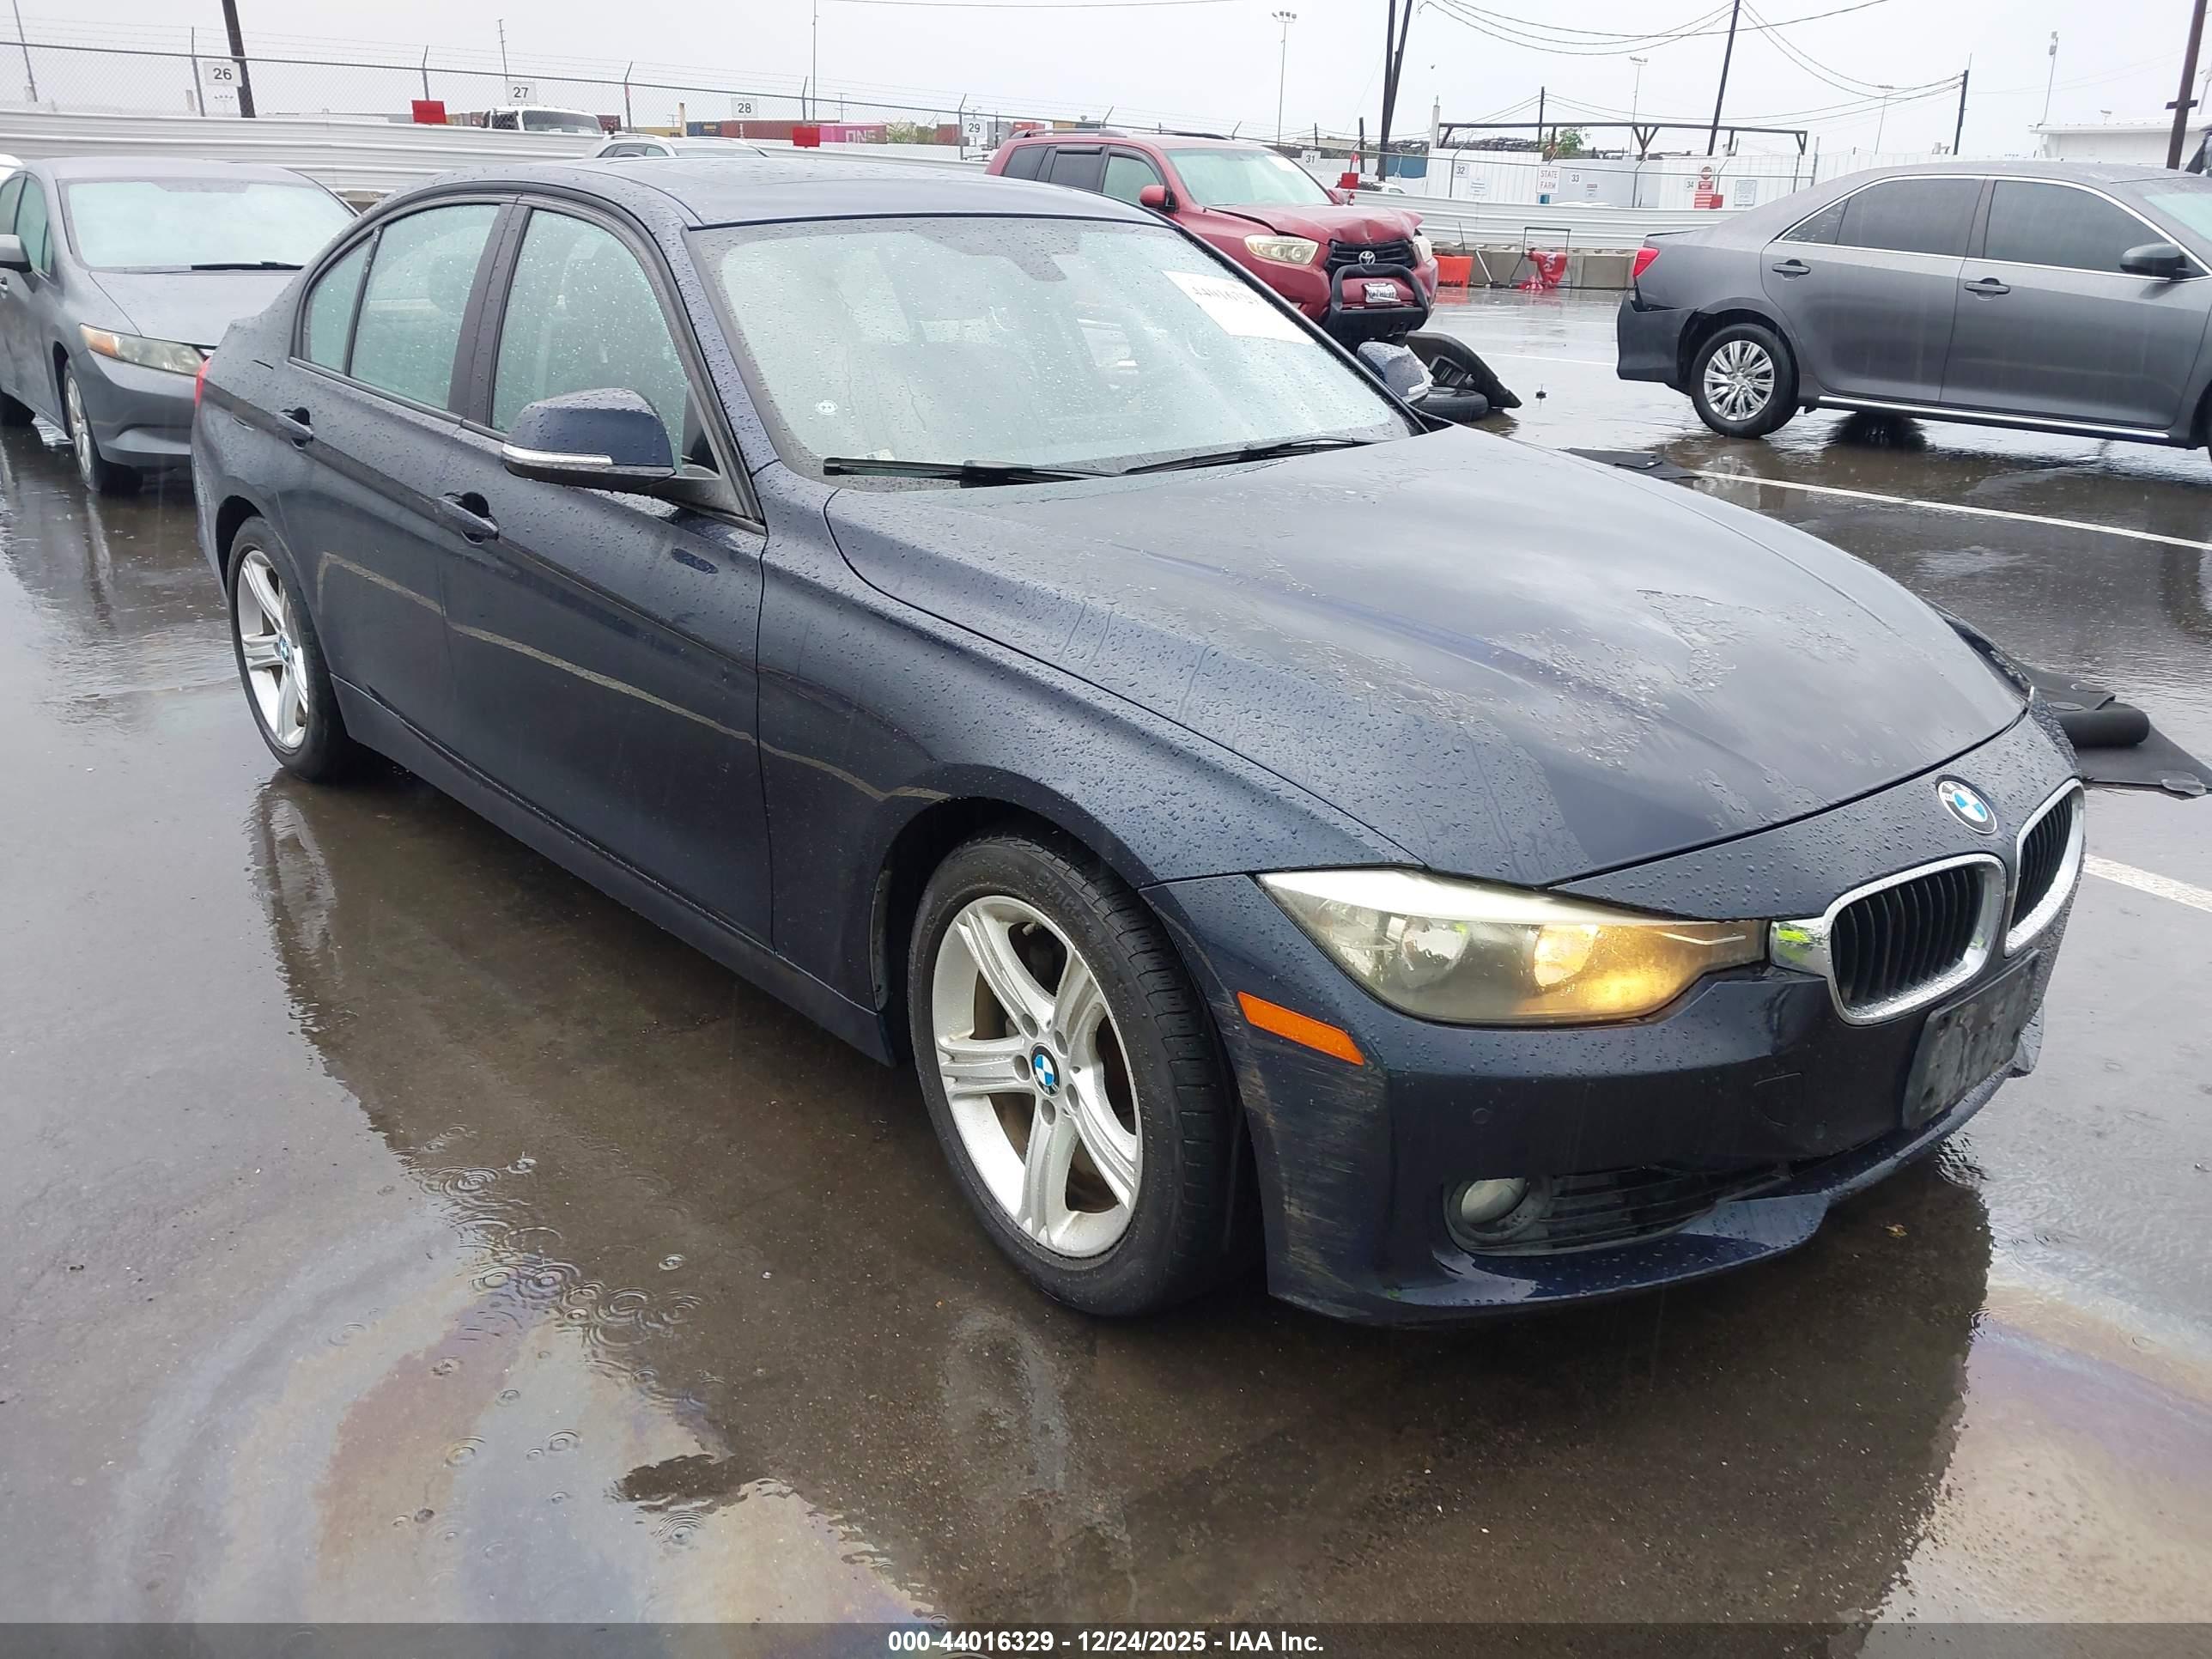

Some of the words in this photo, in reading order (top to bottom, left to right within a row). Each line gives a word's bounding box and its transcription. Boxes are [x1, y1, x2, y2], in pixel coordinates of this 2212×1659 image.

[212, 67, 233, 81] 26
[513, 87, 529, 98] 27
[738, 102, 751, 113] 28
[968, 122, 981, 133] 29
[1305, 155, 1316, 164] 31
[1455, 165, 1465, 175] 32
[1540, 170, 1559, 179] STATE
[1571, 173, 1580, 183] 33
[1540, 180, 1557, 190] FARM
